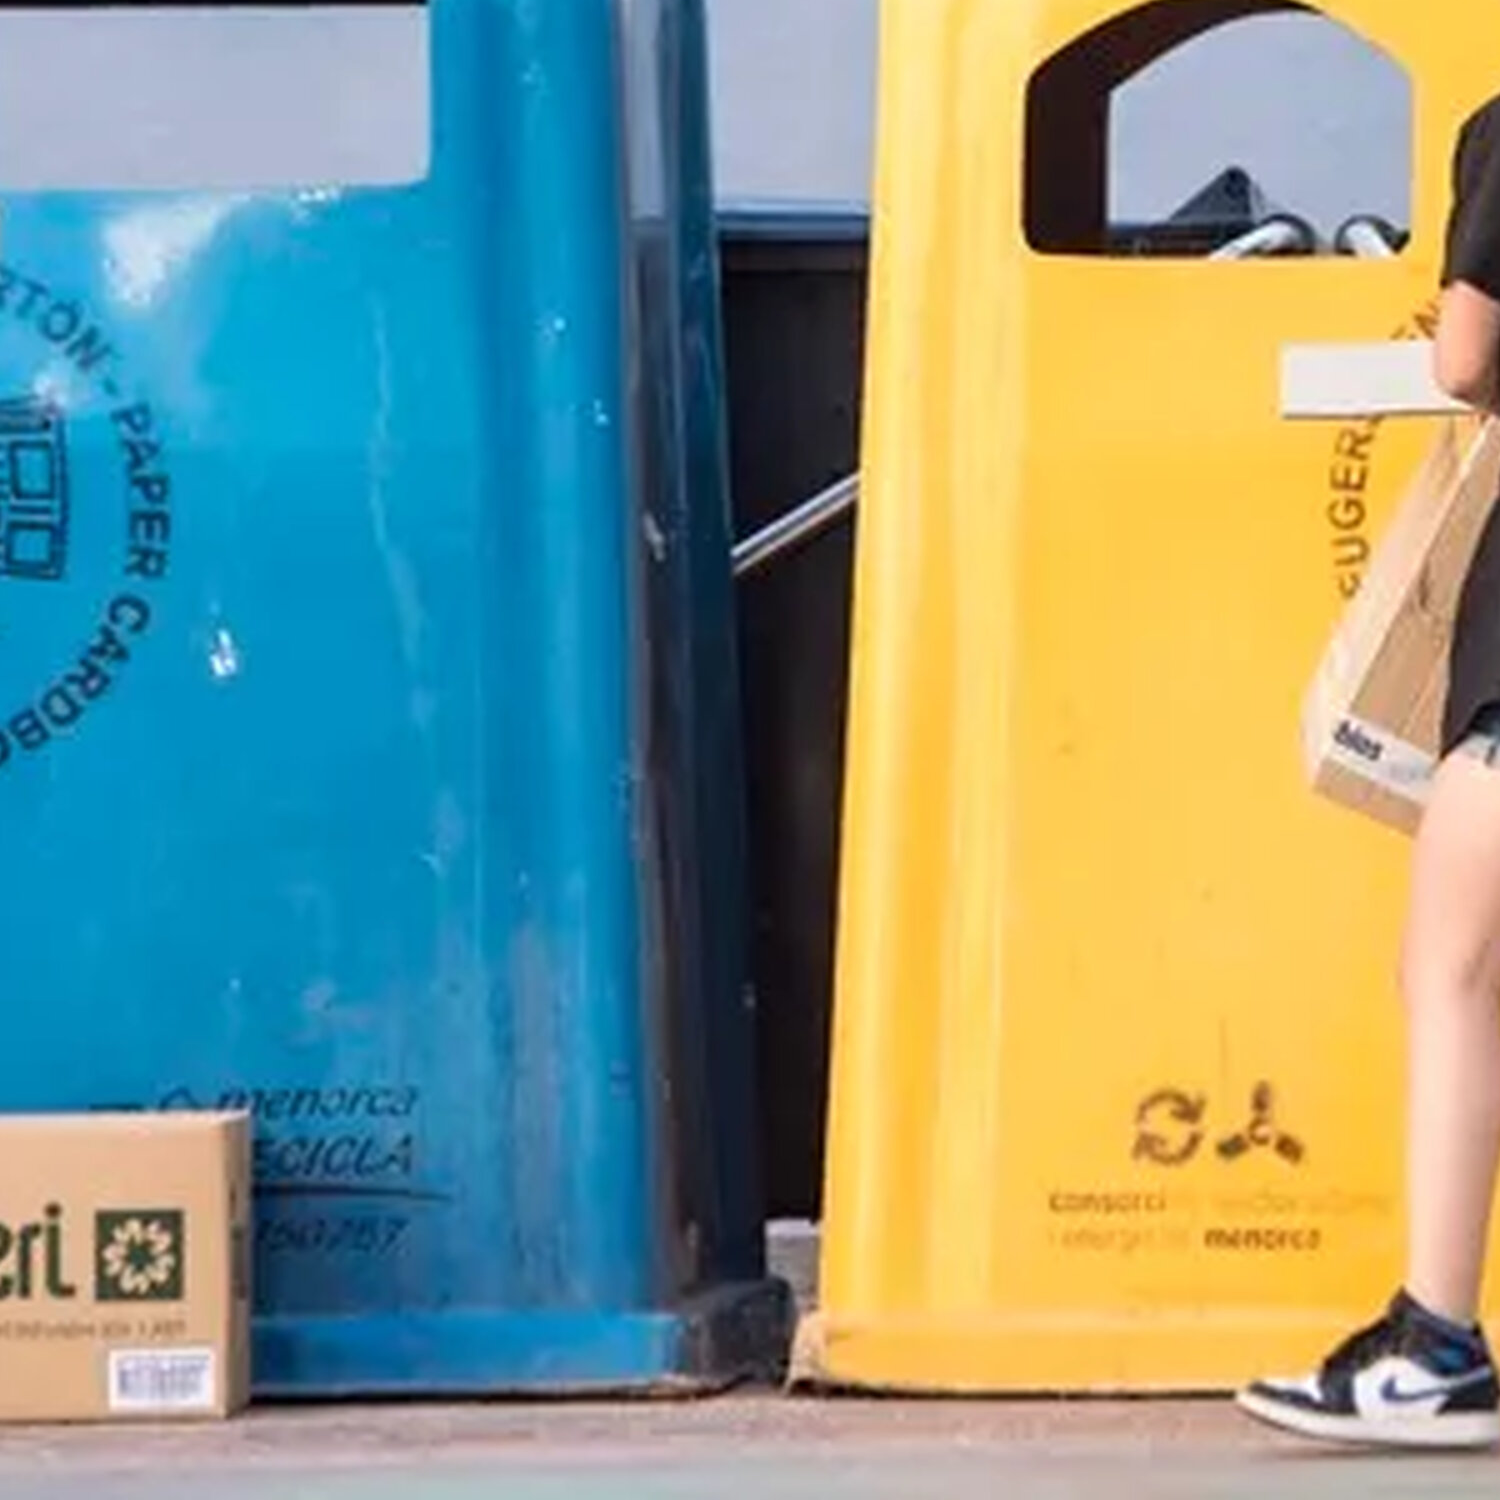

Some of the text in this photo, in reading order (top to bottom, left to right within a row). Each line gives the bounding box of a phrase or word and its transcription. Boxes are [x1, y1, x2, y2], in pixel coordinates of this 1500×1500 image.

[110, 403, 171, 579] PAPER
[252, 1134, 412, 1176] ECICLA
[1204, 1229, 1321, 1250] menorca
